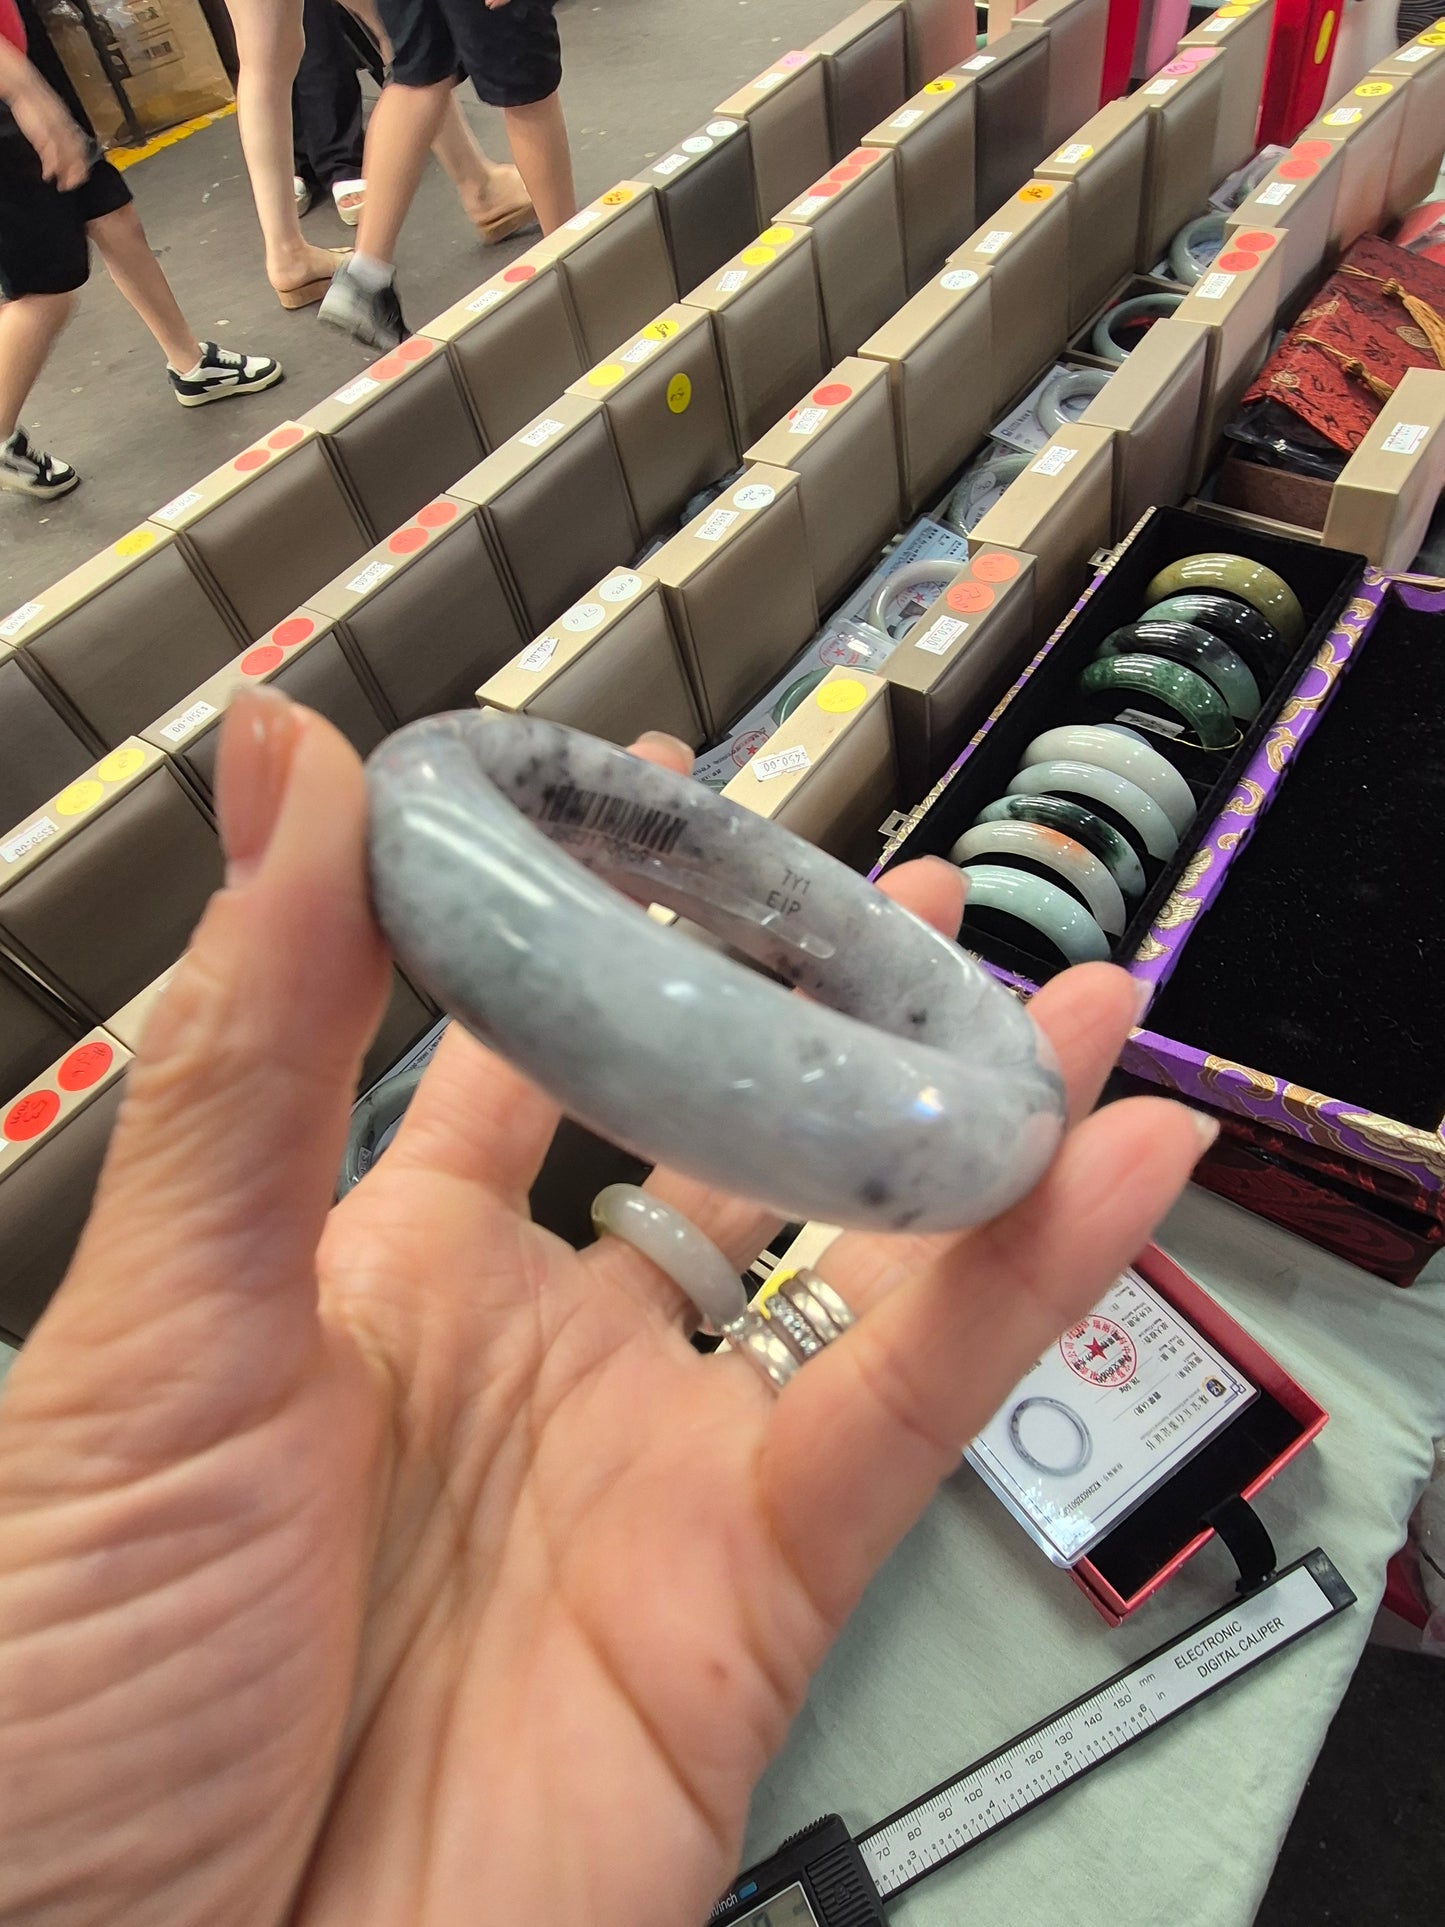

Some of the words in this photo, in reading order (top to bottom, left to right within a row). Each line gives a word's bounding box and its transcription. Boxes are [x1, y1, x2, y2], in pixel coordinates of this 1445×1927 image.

[704, 512, 730, 536] $450.00
[928, 619, 958, 647] $450.00
[172, 706, 208, 733] $350.00
[763, 752, 806, 773] $450.00
[781, 868, 811, 895] TY1
[1173, 1620, 1242, 1670] ELECTRONIC
[1197, 1647, 1241, 1678] DIGITAL
[1237, 1616, 1285, 1657] CALIPER
[1156, 1689, 1166, 1701] in
[875, 1846, 890, 1861] 70
[907, 1826, 922, 1841] 80
[938, 1807, 952, 1821] 90
[964, 1788, 983, 1804] 100
[994, 1769, 1012, 1784] 110
[1024, 1749, 1043, 1766] 120
[1054, 1730, 1073, 1746] 130
[1084, 1712, 1102, 1727] 140
[1113, 1694, 1131, 1709] 150
[1138, 1672, 1156, 1688] mm
